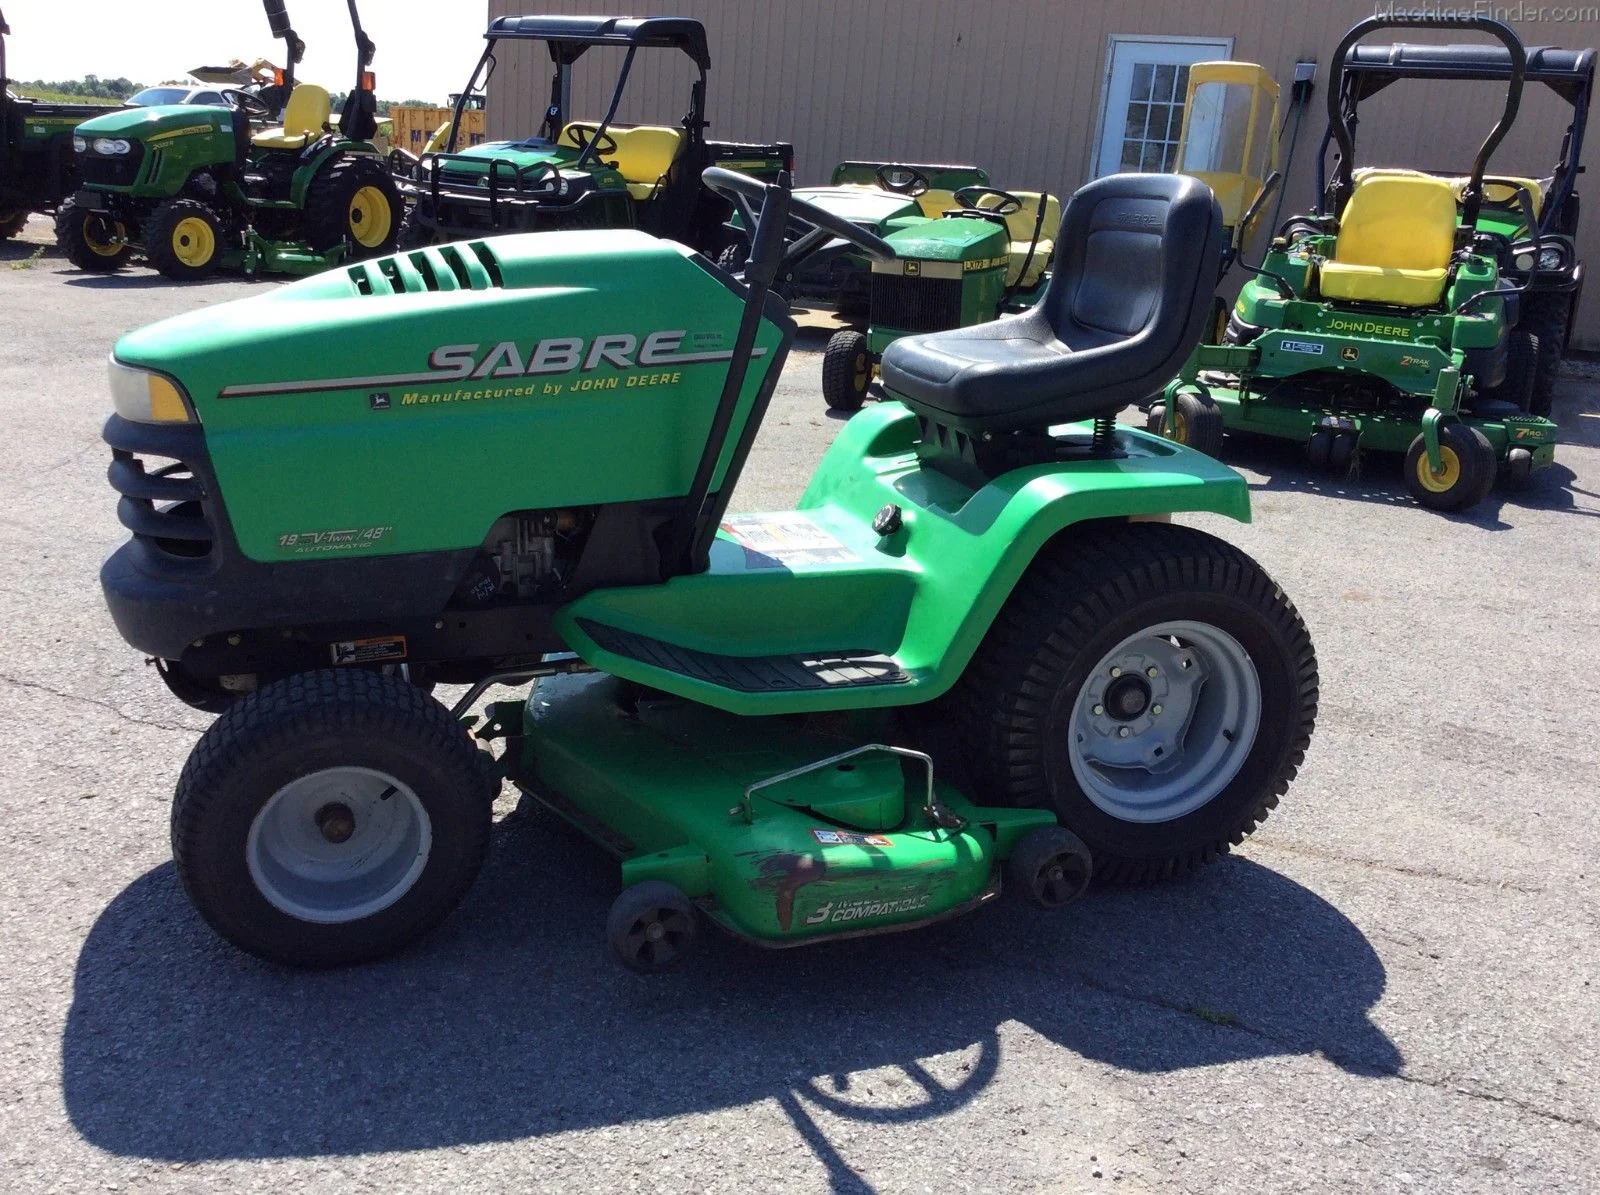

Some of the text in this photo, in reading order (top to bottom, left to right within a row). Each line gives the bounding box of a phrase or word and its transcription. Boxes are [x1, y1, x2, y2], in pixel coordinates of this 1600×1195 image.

[1326, 318, 1411, 337] JOHN DEERE
[429, 329, 687, 380] SABRE
[401, 372, 682, 405] Manufactured by JOHN DEERE
